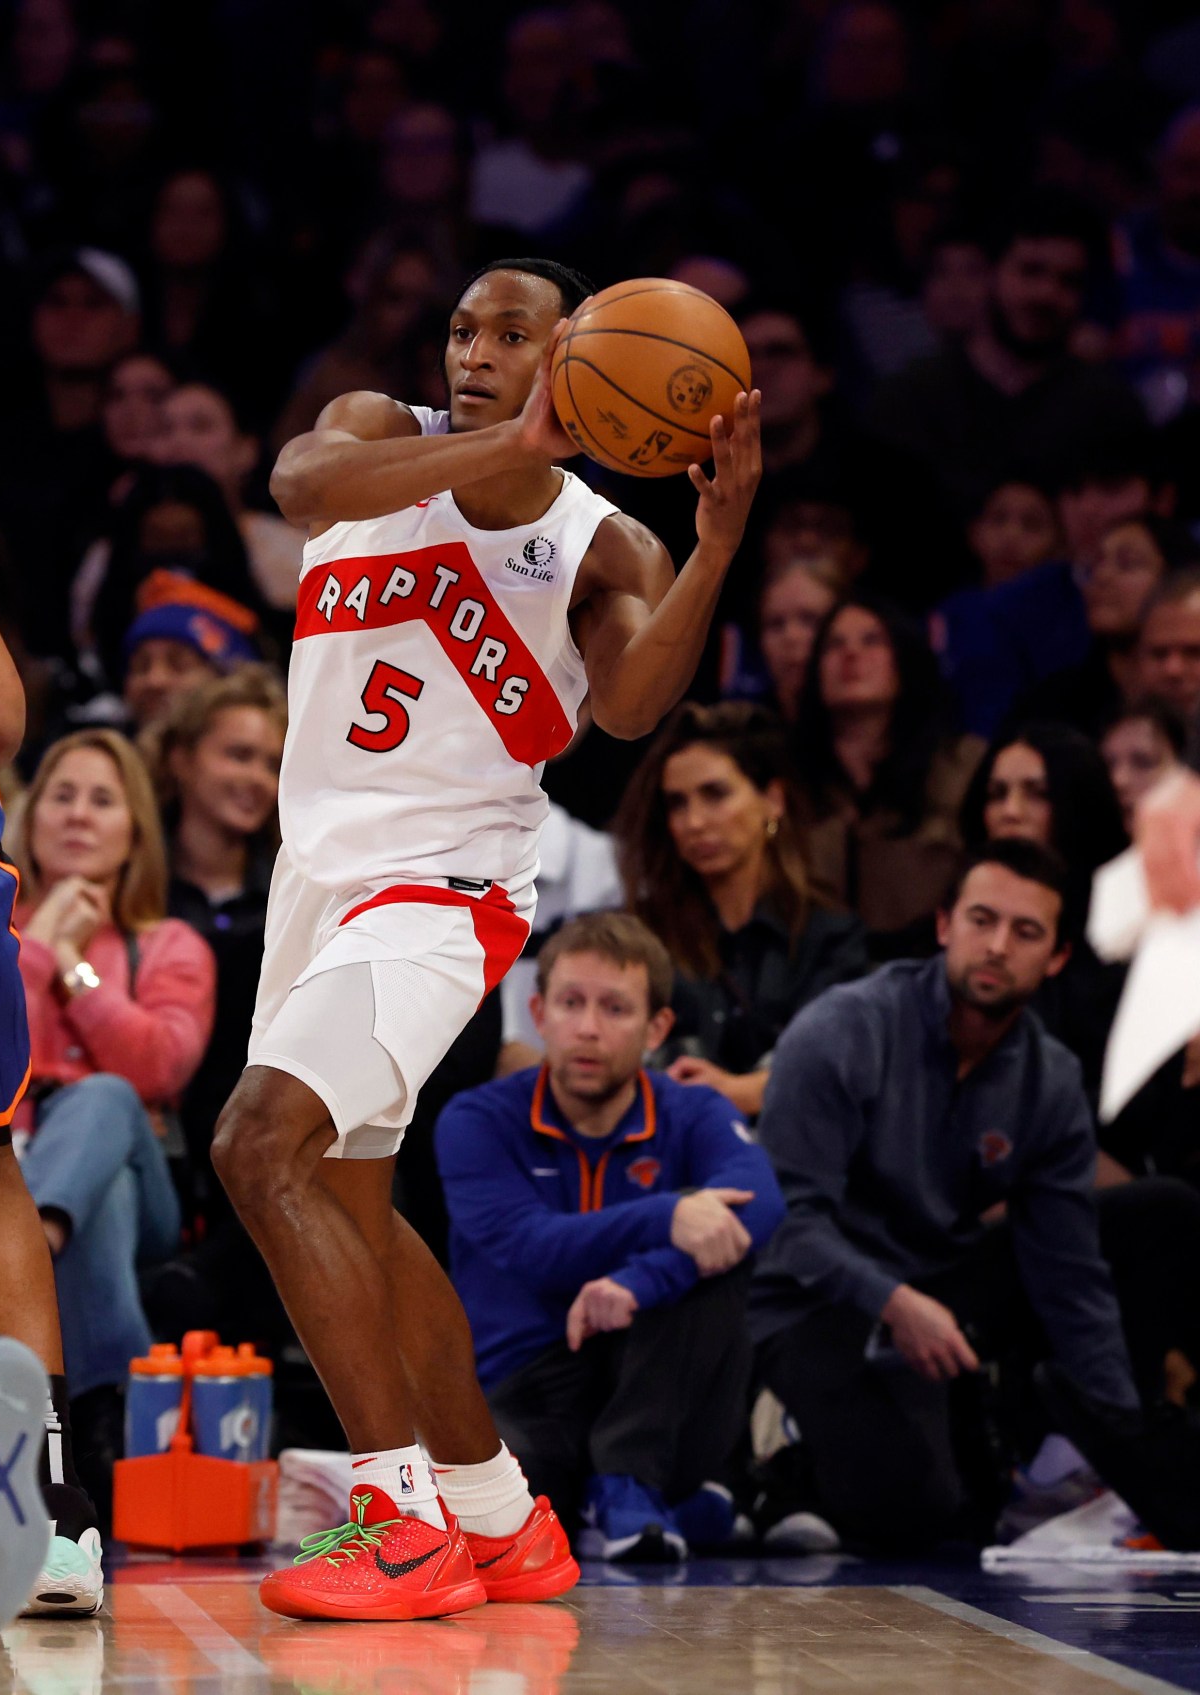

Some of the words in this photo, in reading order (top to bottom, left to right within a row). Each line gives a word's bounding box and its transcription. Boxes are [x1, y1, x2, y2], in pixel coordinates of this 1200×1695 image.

[504, 557, 529, 577] Sun
[530, 567, 554, 583] Life
[315, 563, 531, 717] RAPTORS
[345, 658, 426, 754] 5
